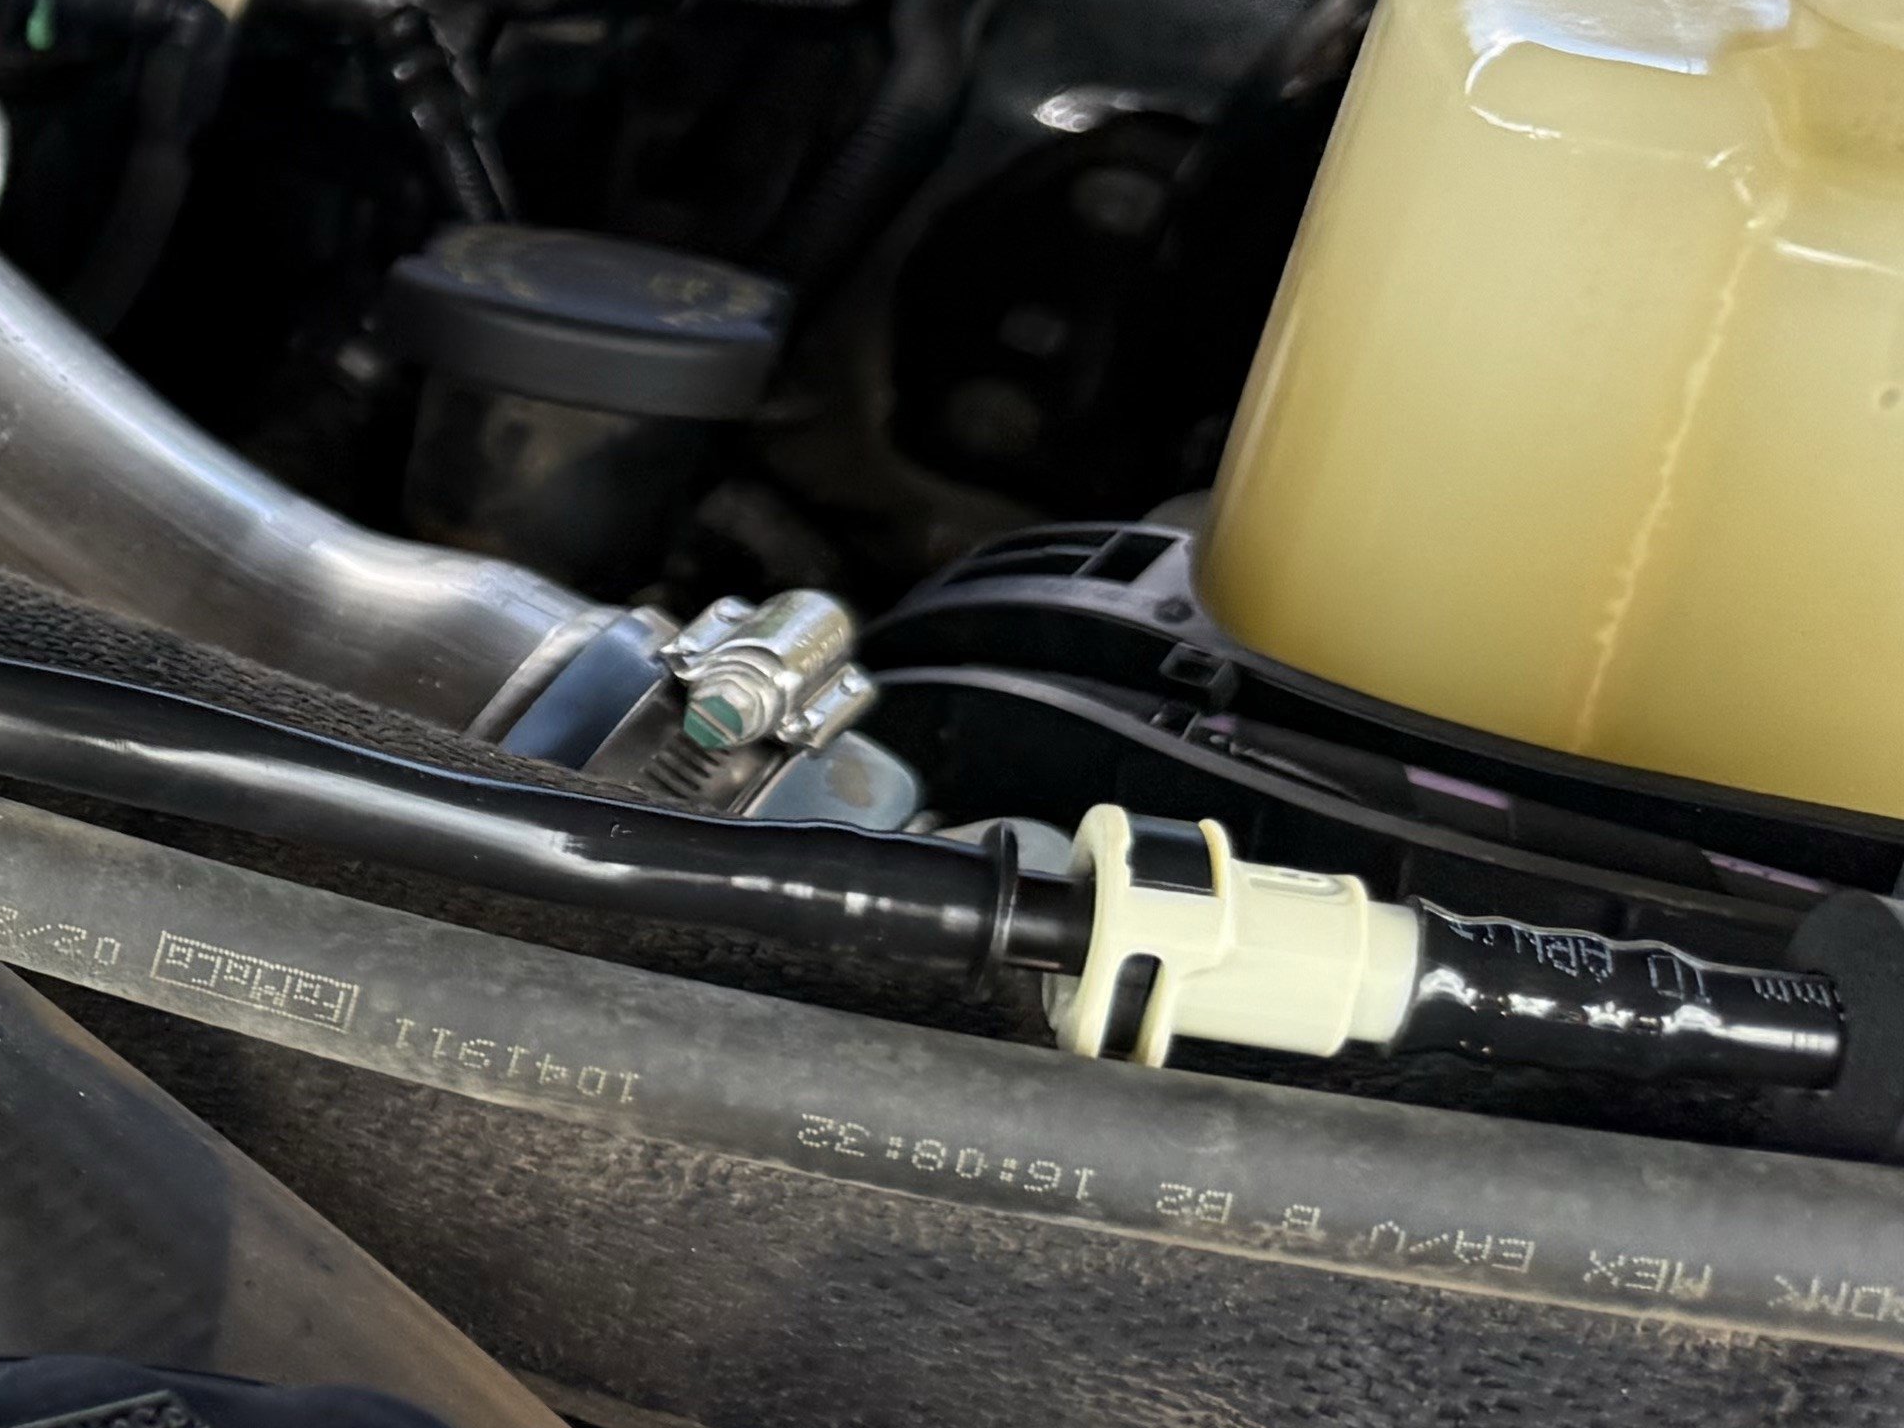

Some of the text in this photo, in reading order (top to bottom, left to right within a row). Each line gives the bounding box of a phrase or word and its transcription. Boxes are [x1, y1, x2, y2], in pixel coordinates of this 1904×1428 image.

[164, 942, 345, 1023] FoMoCo
[389, 1014, 641, 1105] 1041911
[794, 1111, 1096, 1201] 16:08:32
[1154, 1179, 1233, 1223] B2
[1279, 1200, 1319, 1238] B
[1582, 1248, 1711, 1299] MEX
